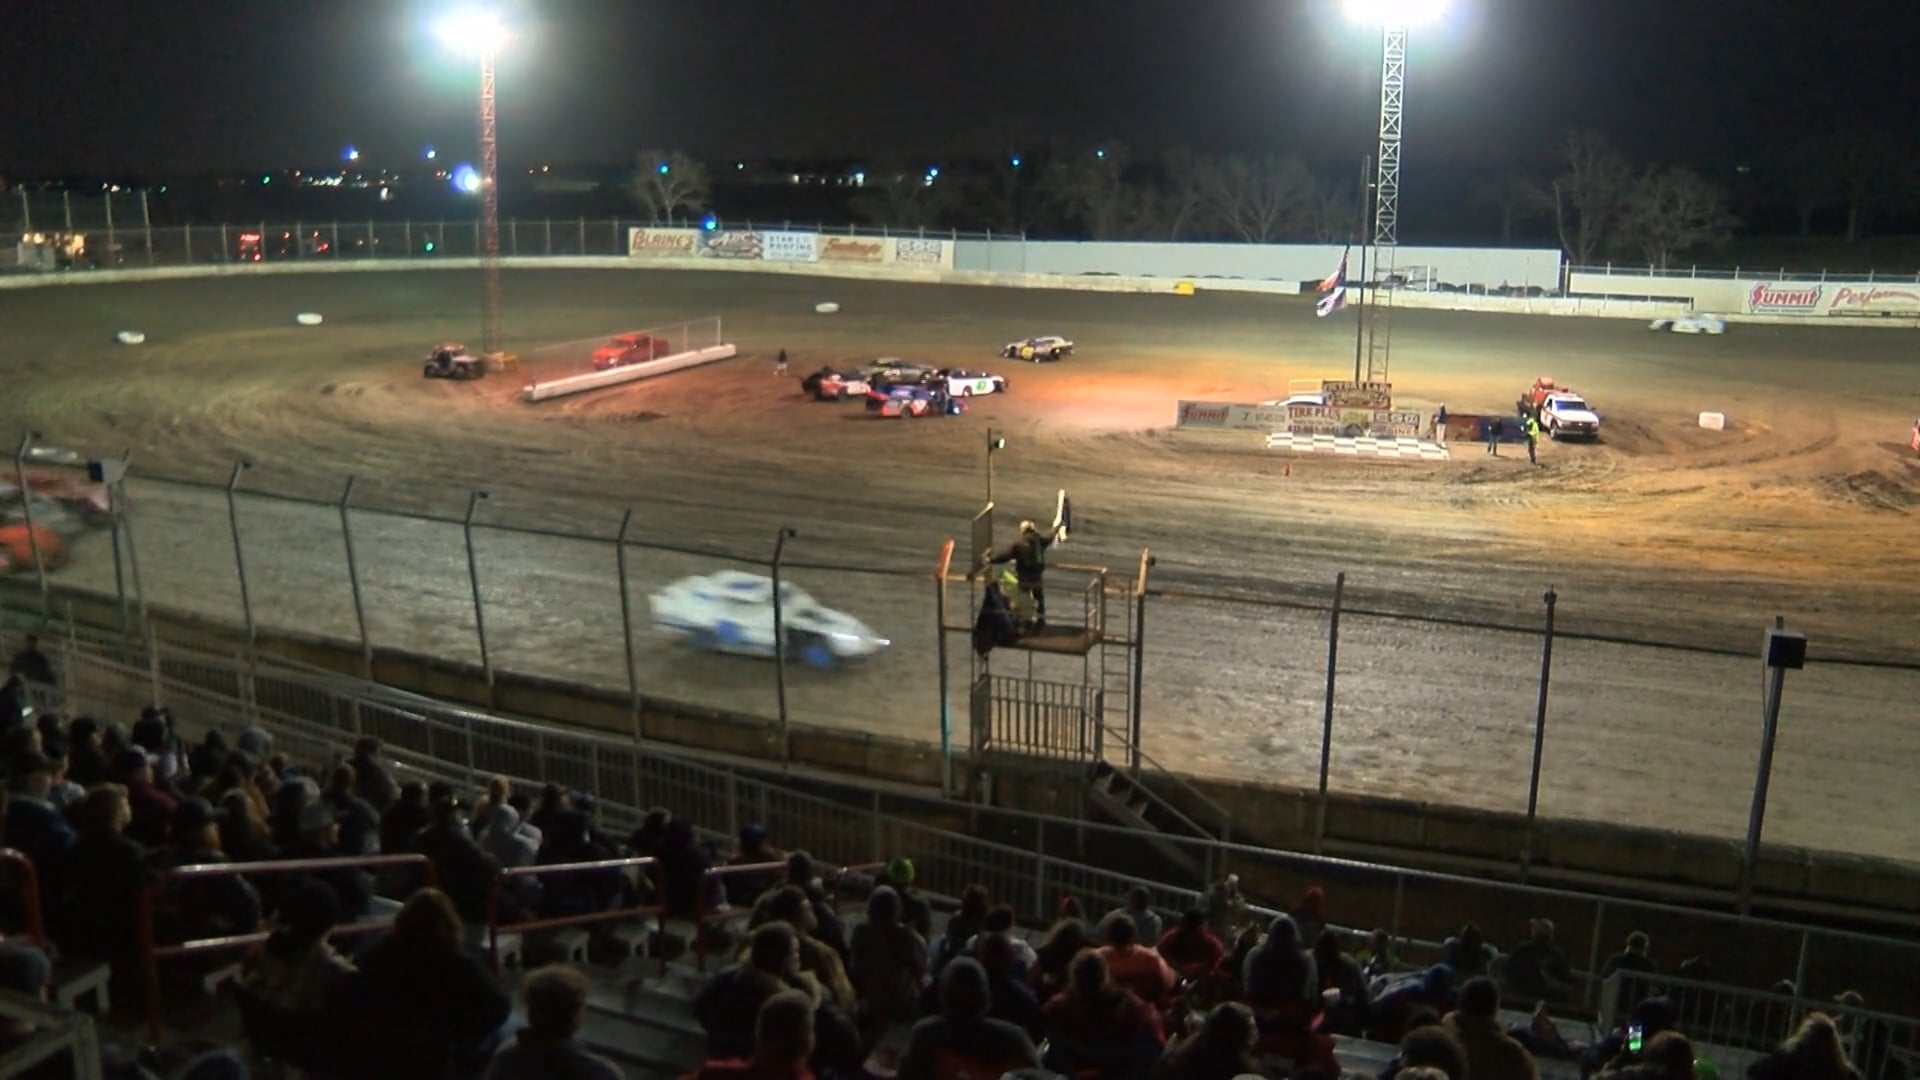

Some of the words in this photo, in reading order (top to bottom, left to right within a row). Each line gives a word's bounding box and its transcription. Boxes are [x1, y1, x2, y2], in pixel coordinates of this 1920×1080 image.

[1750, 284, 1821, 308] SUMMIT
[1288, 407, 1312, 418] TIRE
[1315, 407, 1341, 420] PLUS
